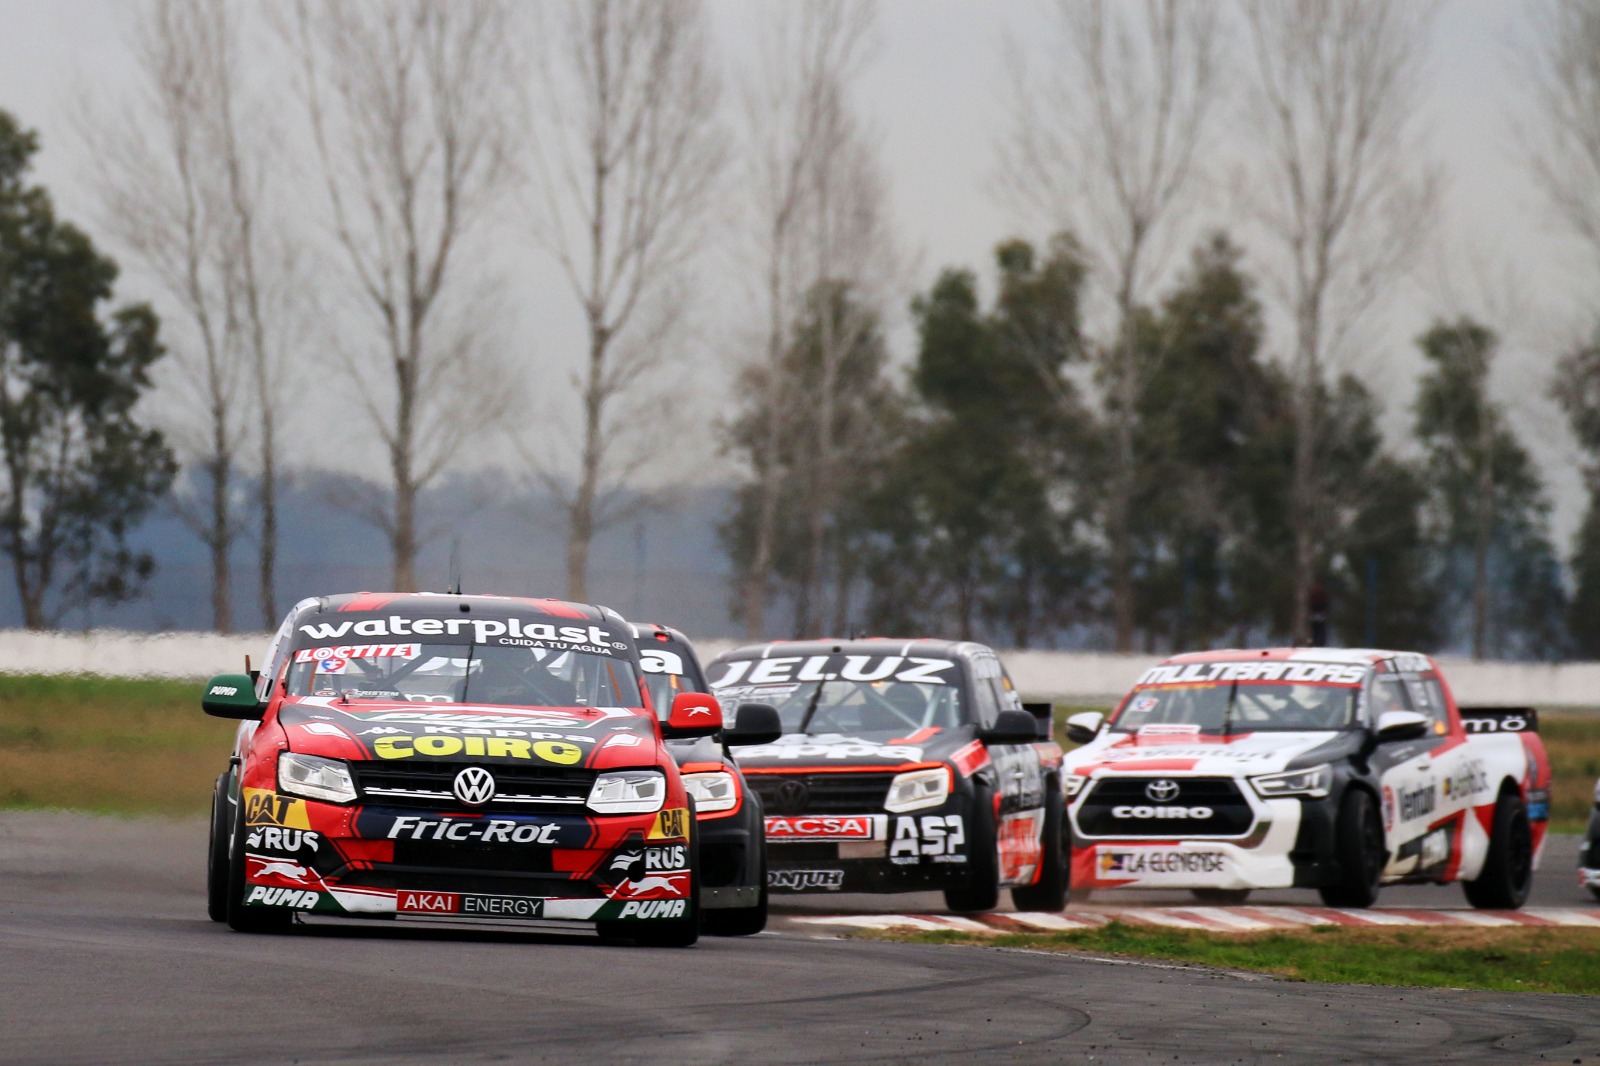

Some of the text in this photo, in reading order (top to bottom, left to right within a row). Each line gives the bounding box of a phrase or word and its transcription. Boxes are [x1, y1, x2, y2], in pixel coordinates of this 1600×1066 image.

[299, 615, 612, 648] waterplast
[296, 643, 411, 663] LOCTITE
[498, 637, 612, 656] CUIDA TU AGUA
[710, 655, 955, 689] JELUZ
[209, 685, 238, 697] PUMA
[374, 735, 583, 765] COIRO
[246, 794, 297, 825] CAT
[1112, 805, 1214, 820] COIRO
[387, 816, 562, 844] Fric-Rot
[246, 885, 320, 910] PUMA
[403, 894, 541, 915] AKAI ENERGY
[618, 899, 686, 920] PUMA
